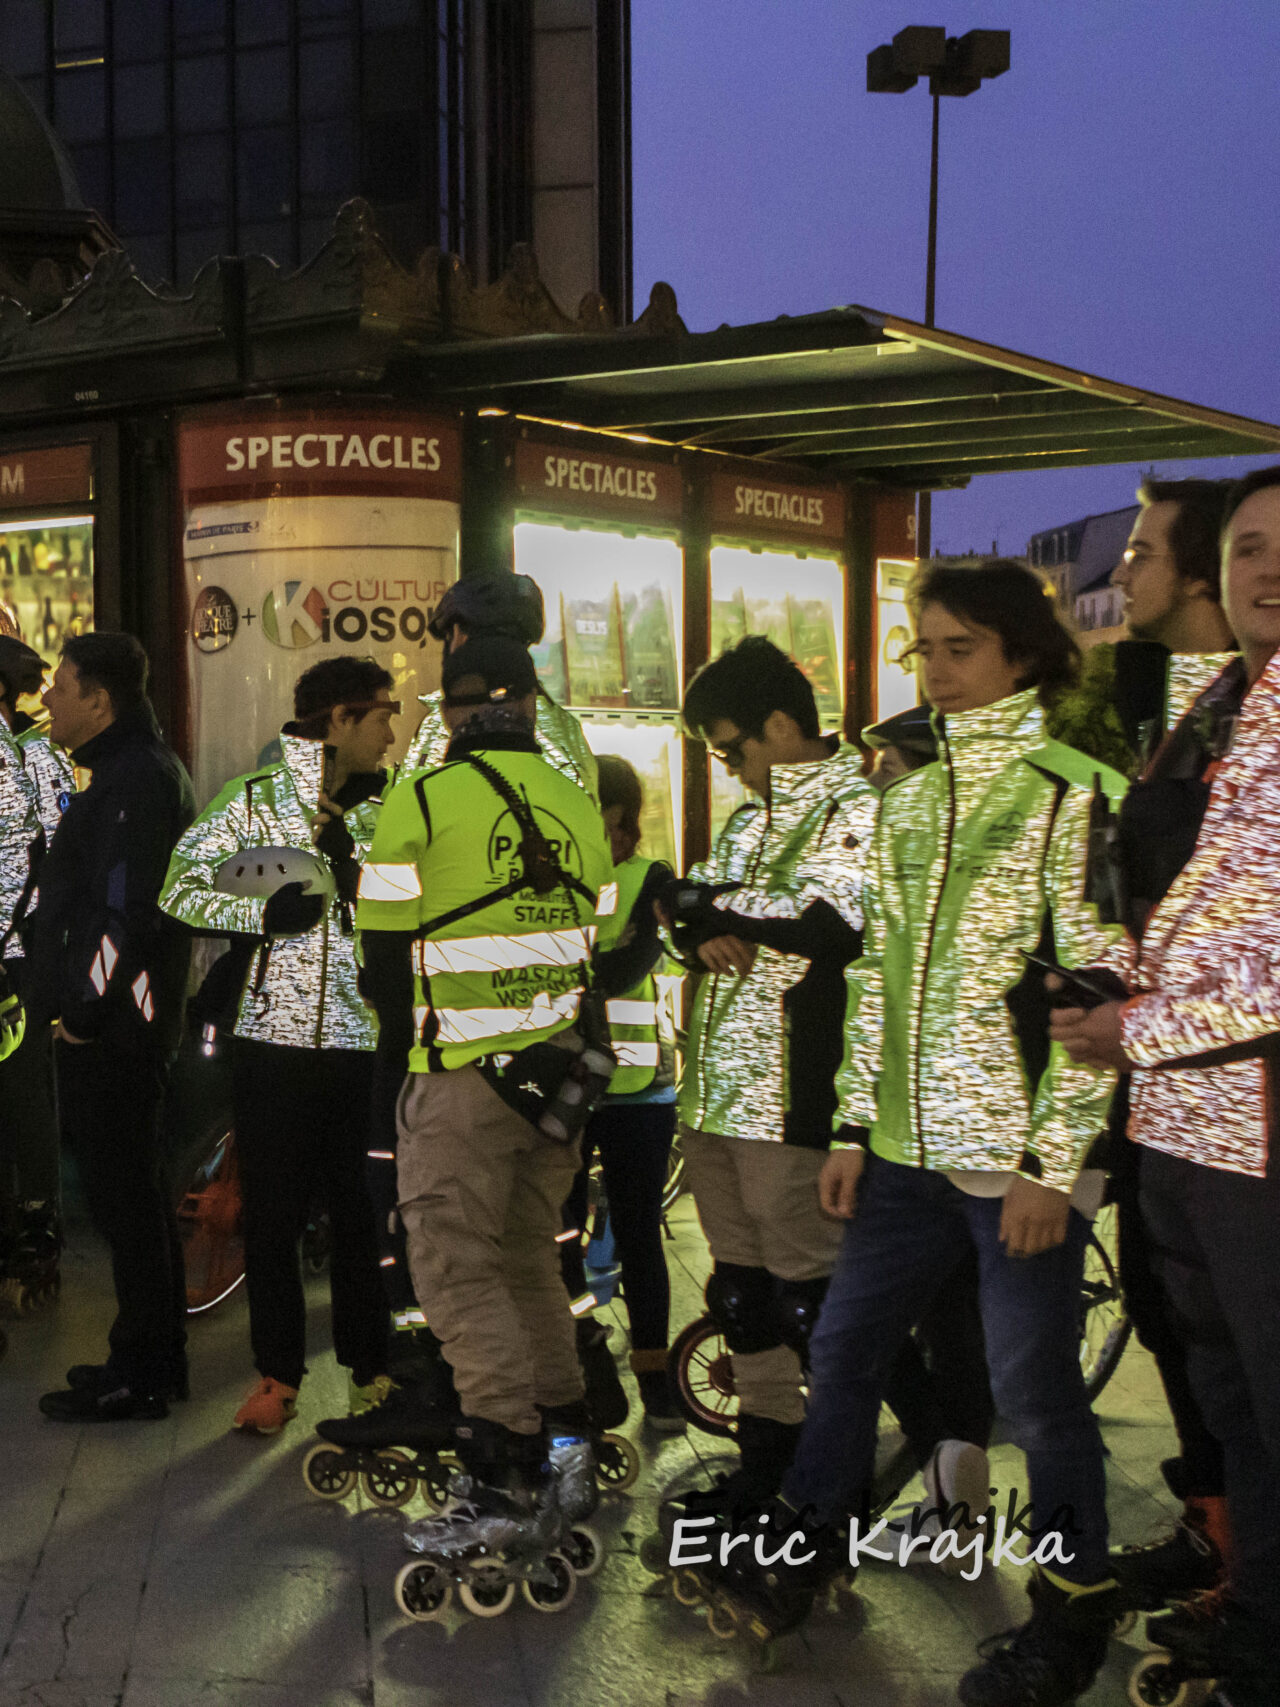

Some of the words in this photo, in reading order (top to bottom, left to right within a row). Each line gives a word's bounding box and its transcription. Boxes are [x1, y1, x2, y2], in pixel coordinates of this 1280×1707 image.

[225, 433, 441, 472] SPECTACLES
[544, 456, 657, 501] SPECTACLES
[734, 485, 824, 526] SPECTACLES
[327, 579, 447, 602] CULTUR
[494, 836, 572, 865] PRI
[514, 905, 572, 926] STAFF
[492, 966, 583, 989] MASC
